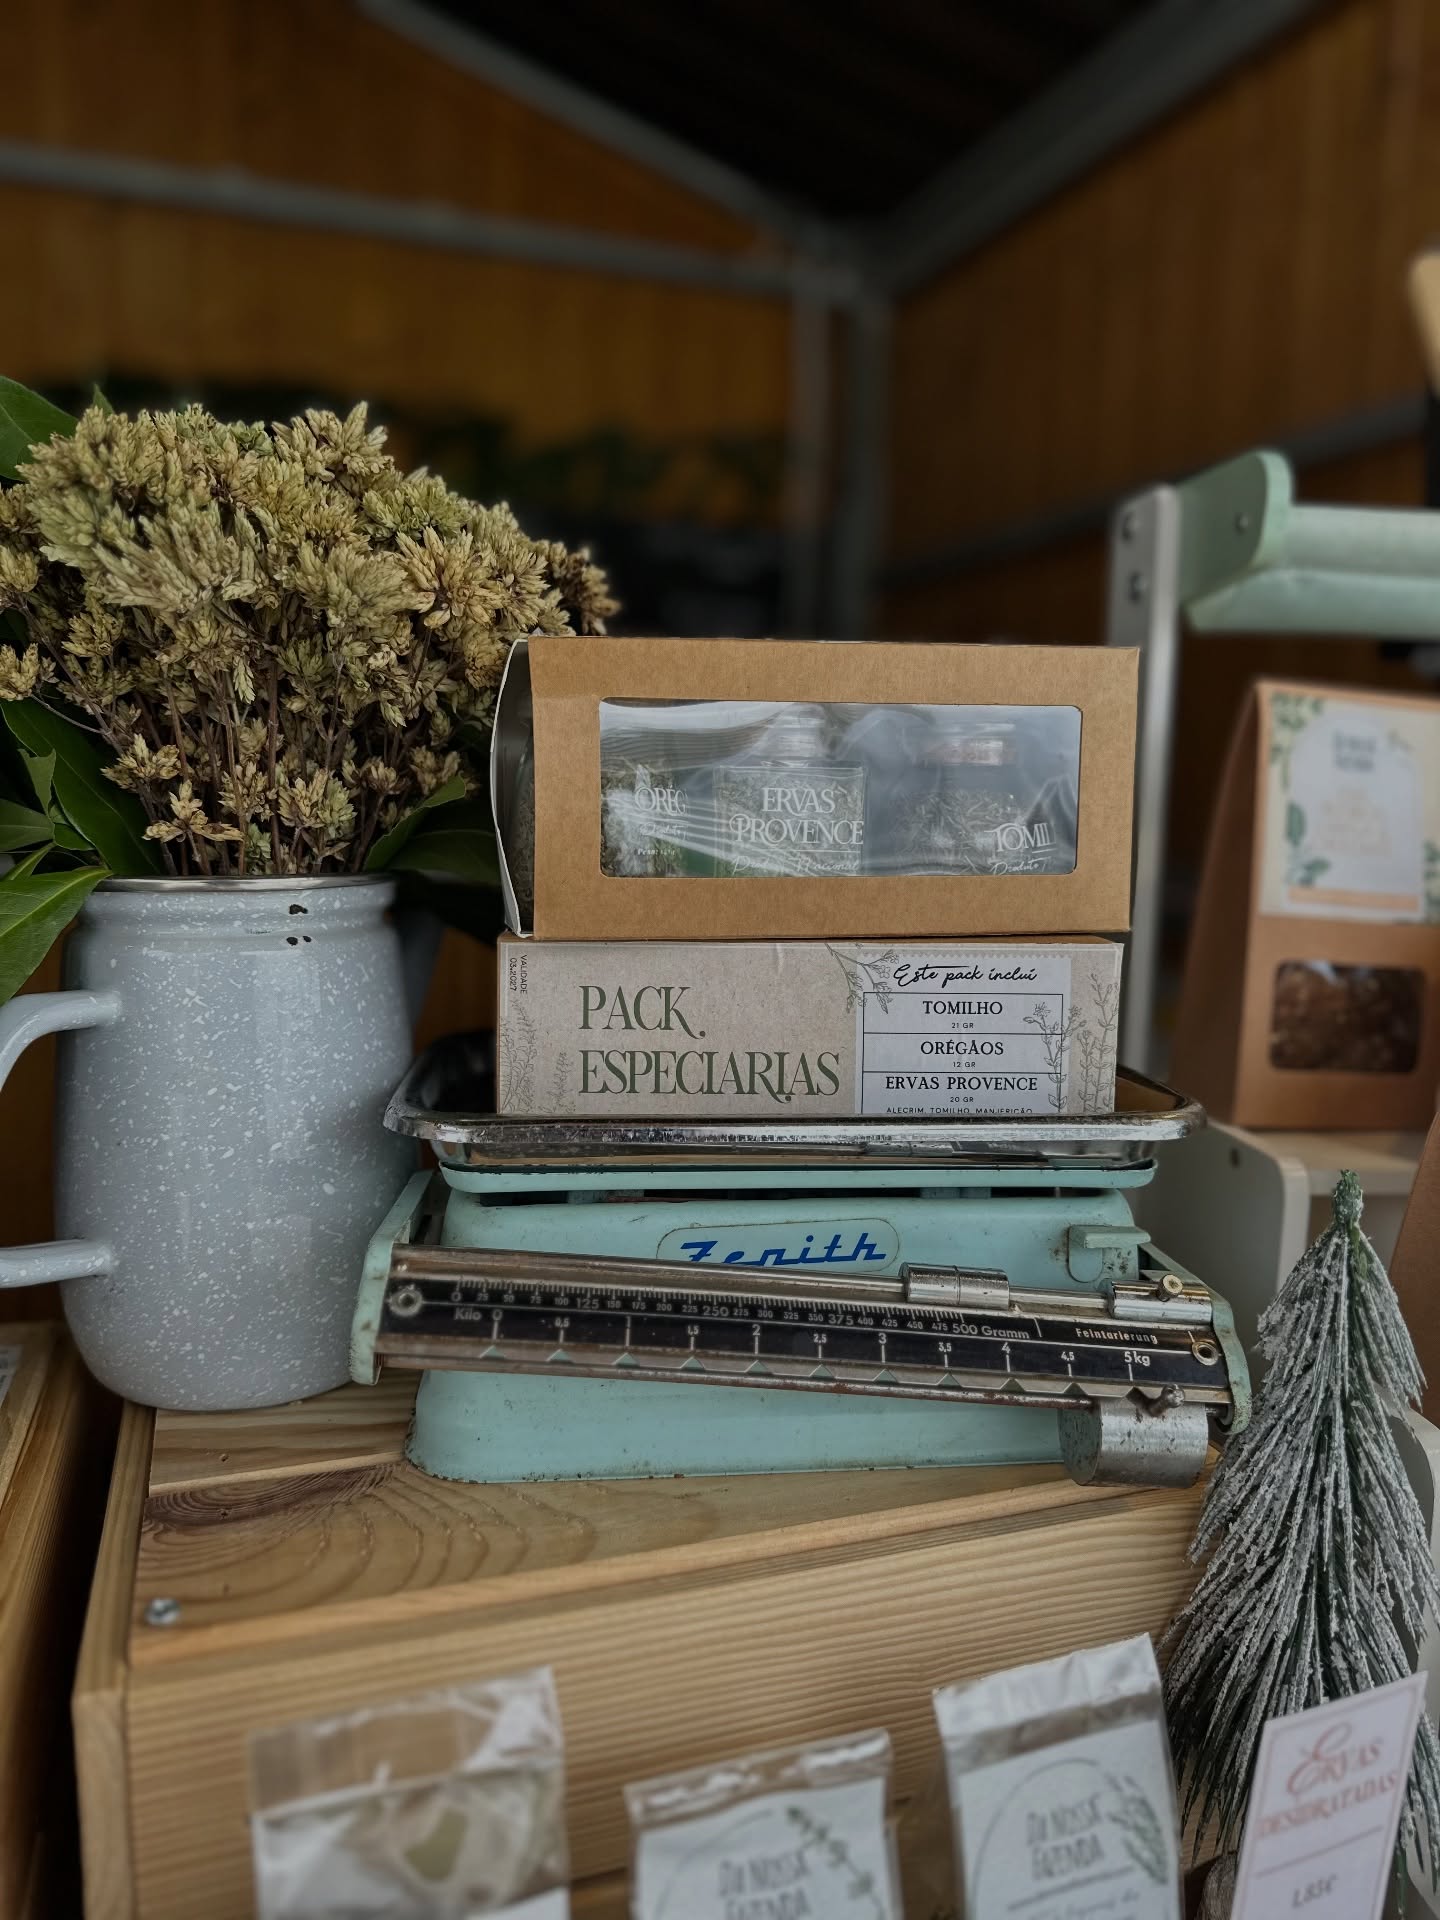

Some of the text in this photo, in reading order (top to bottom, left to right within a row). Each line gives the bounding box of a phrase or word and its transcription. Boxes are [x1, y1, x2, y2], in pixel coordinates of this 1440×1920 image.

[761, 787, 836, 816] ERVAS
[729, 813, 864, 847] PROVENCE
[509, 957, 518, 992] 03.2027
[520, 954, 528, 995] VALIDADE
[893, 964, 945, 987] Este
[941, 965, 984, 988] pack
[579, 985, 705, 1039] PACK
[922, 1001, 1003, 1015] TOMILHO
[579, 1050, 840, 1104] ESPECIARIAS
[885, 1076, 1038, 1091] ERVAS PROVENCE
[680, 1232, 887, 1266] Zenith
[454, 1307, 482, 1321] Kilo
[492, 1309, 503, 1321] 0
[751, 1324, 761, 1336] 2
[878, 1332, 887, 1345] 3
[1001, 1341, 1011, 1354] 4
[503, 1294, 515, 1303] 50
[554, 1297, 569, 1306] 100
[576, 1298, 600, 1310] 125
[632, 1301, 646, 1311] 175
[656, 1303, 673, 1312] 200
[682, 1304, 698, 1314] 225
[703, 1305, 729, 1317] 250
[733, 1307, 749, 1317] 275
[757, 1309, 773, 1319] 300
[783, 1311, 799, 1321] 325
[808, 1312, 824, 1322] 350
[828, 1313, 854, 1326] 375
[857, 1317, 874, 1326] 400
[881, 1318, 898, 1328] 425
[906, 1321, 923, 1330] 450
[931, 1322, 948, 1331] 475
[952, 1323, 978, 1335] 500
[981, 1324, 1030, 1340] Gramm
[1075, 1327, 1158, 1345] Feintarierung
